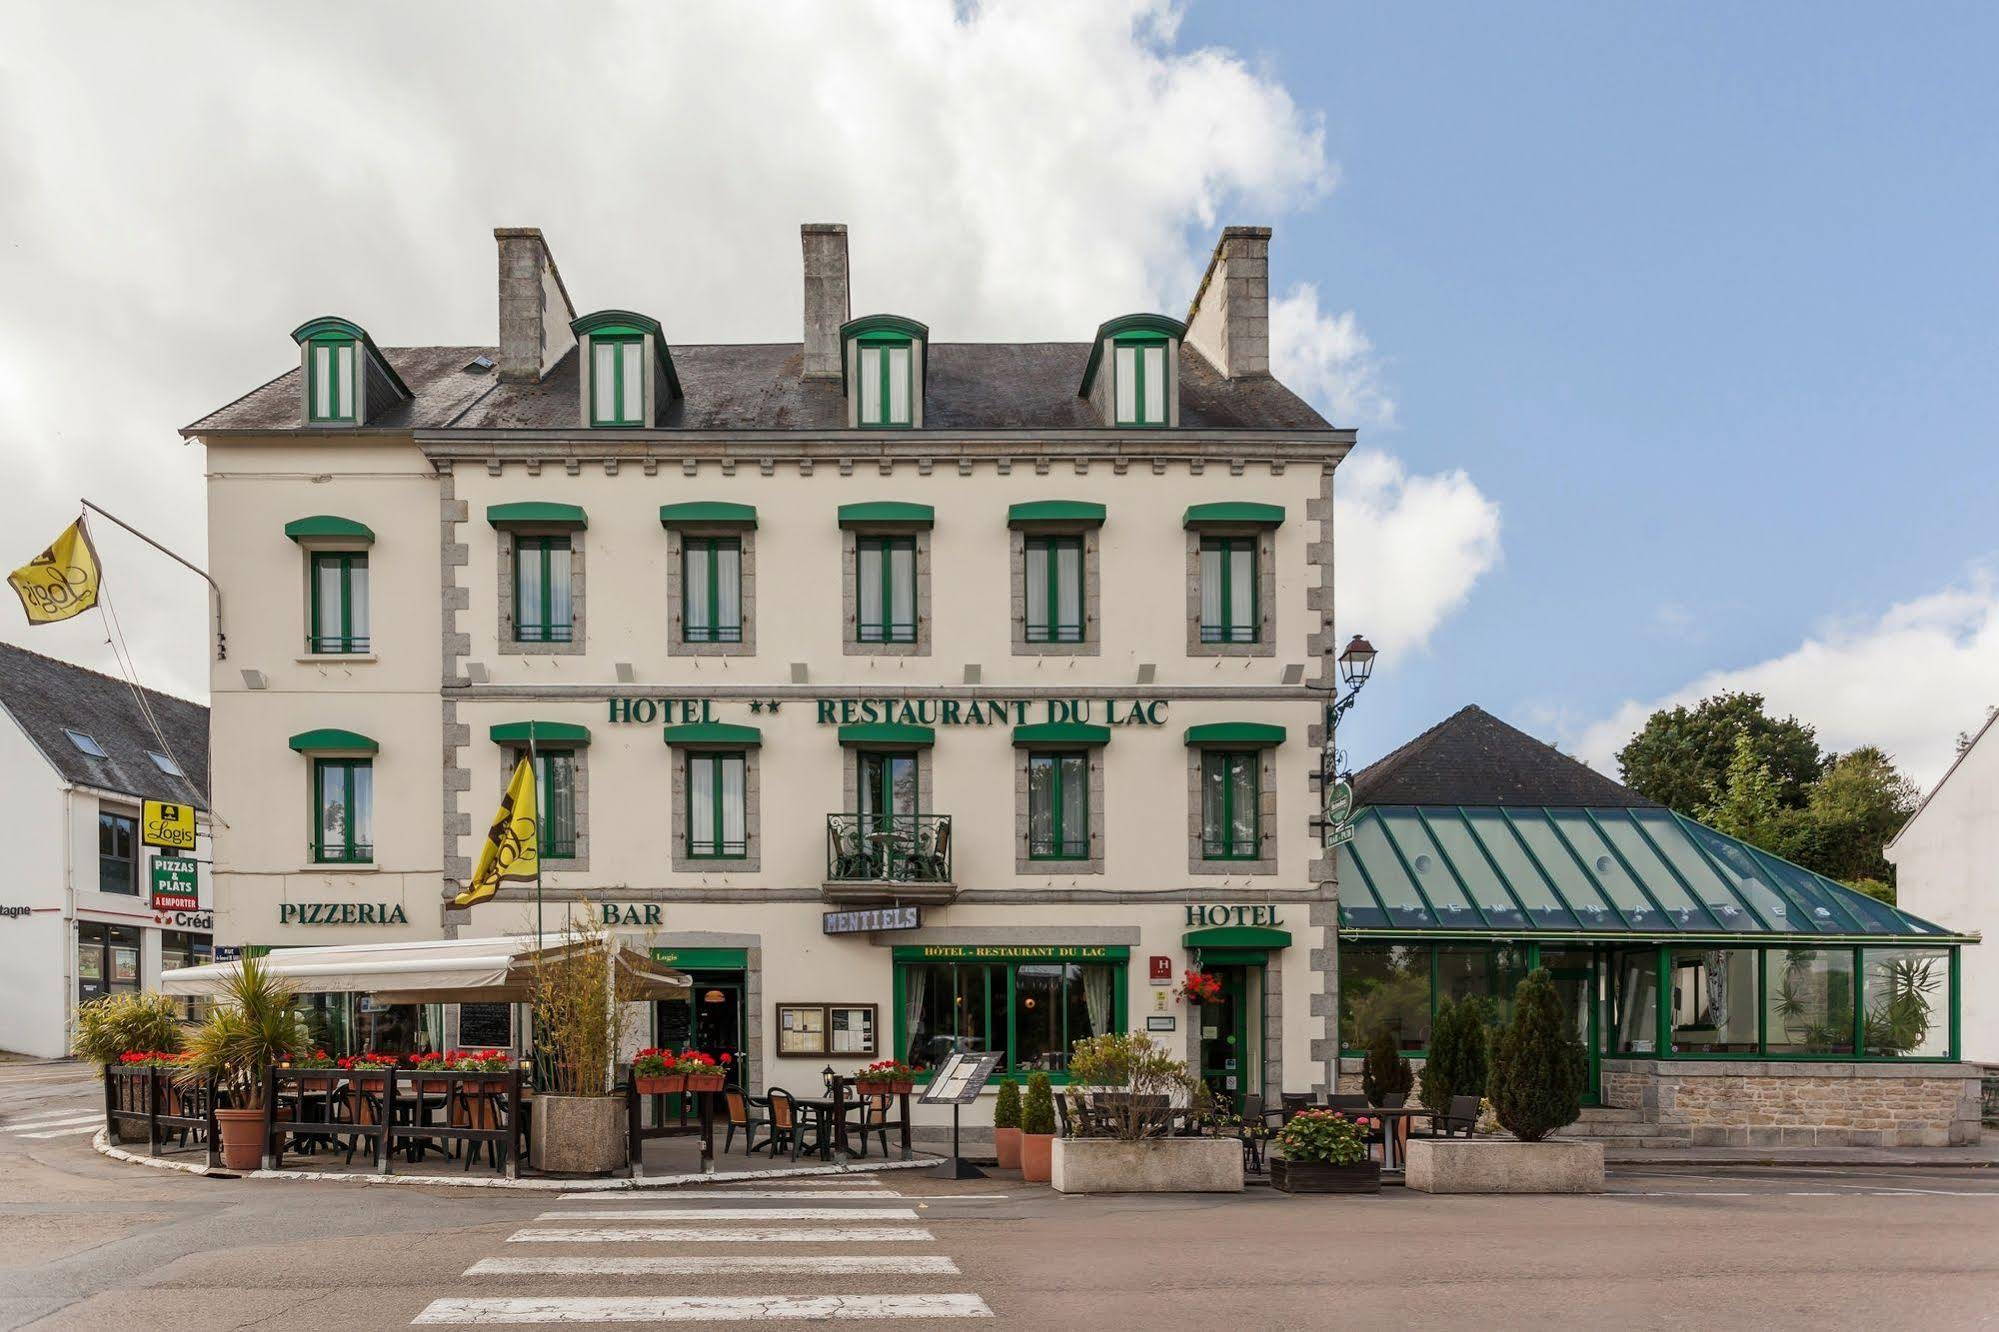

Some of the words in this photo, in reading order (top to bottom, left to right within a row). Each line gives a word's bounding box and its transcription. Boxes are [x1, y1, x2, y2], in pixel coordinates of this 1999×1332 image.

[607, 698, 720, 724] HOTEL
[816, 698, 1031, 725] RESTAURANT
[1048, 699, 1090, 724] DU
[1105, 699, 1169, 725] LAC
[147, 820, 193, 844] Logis
[155, 860, 195, 873] PIZZAS
[171, 872, 179, 881] &
[159, 880, 193, 892] PLATS
[163, 897, 197, 908] EMPORTER
[279, 903, 408, 924] PIZZERIA
[601, 903, 664, 925] BAR
[826, 907, 917, 933] MENTIELS
[1185, 905, 1285, 927] HOTEL
[657, 953, 678, 962] Logis
[977, 948, 1054, 957] RESTAURANT
[1060, 948, 1076, 957] DU
[1083, 948, 1106, 957] LAC
[1160, 960, 1169, 969] H
